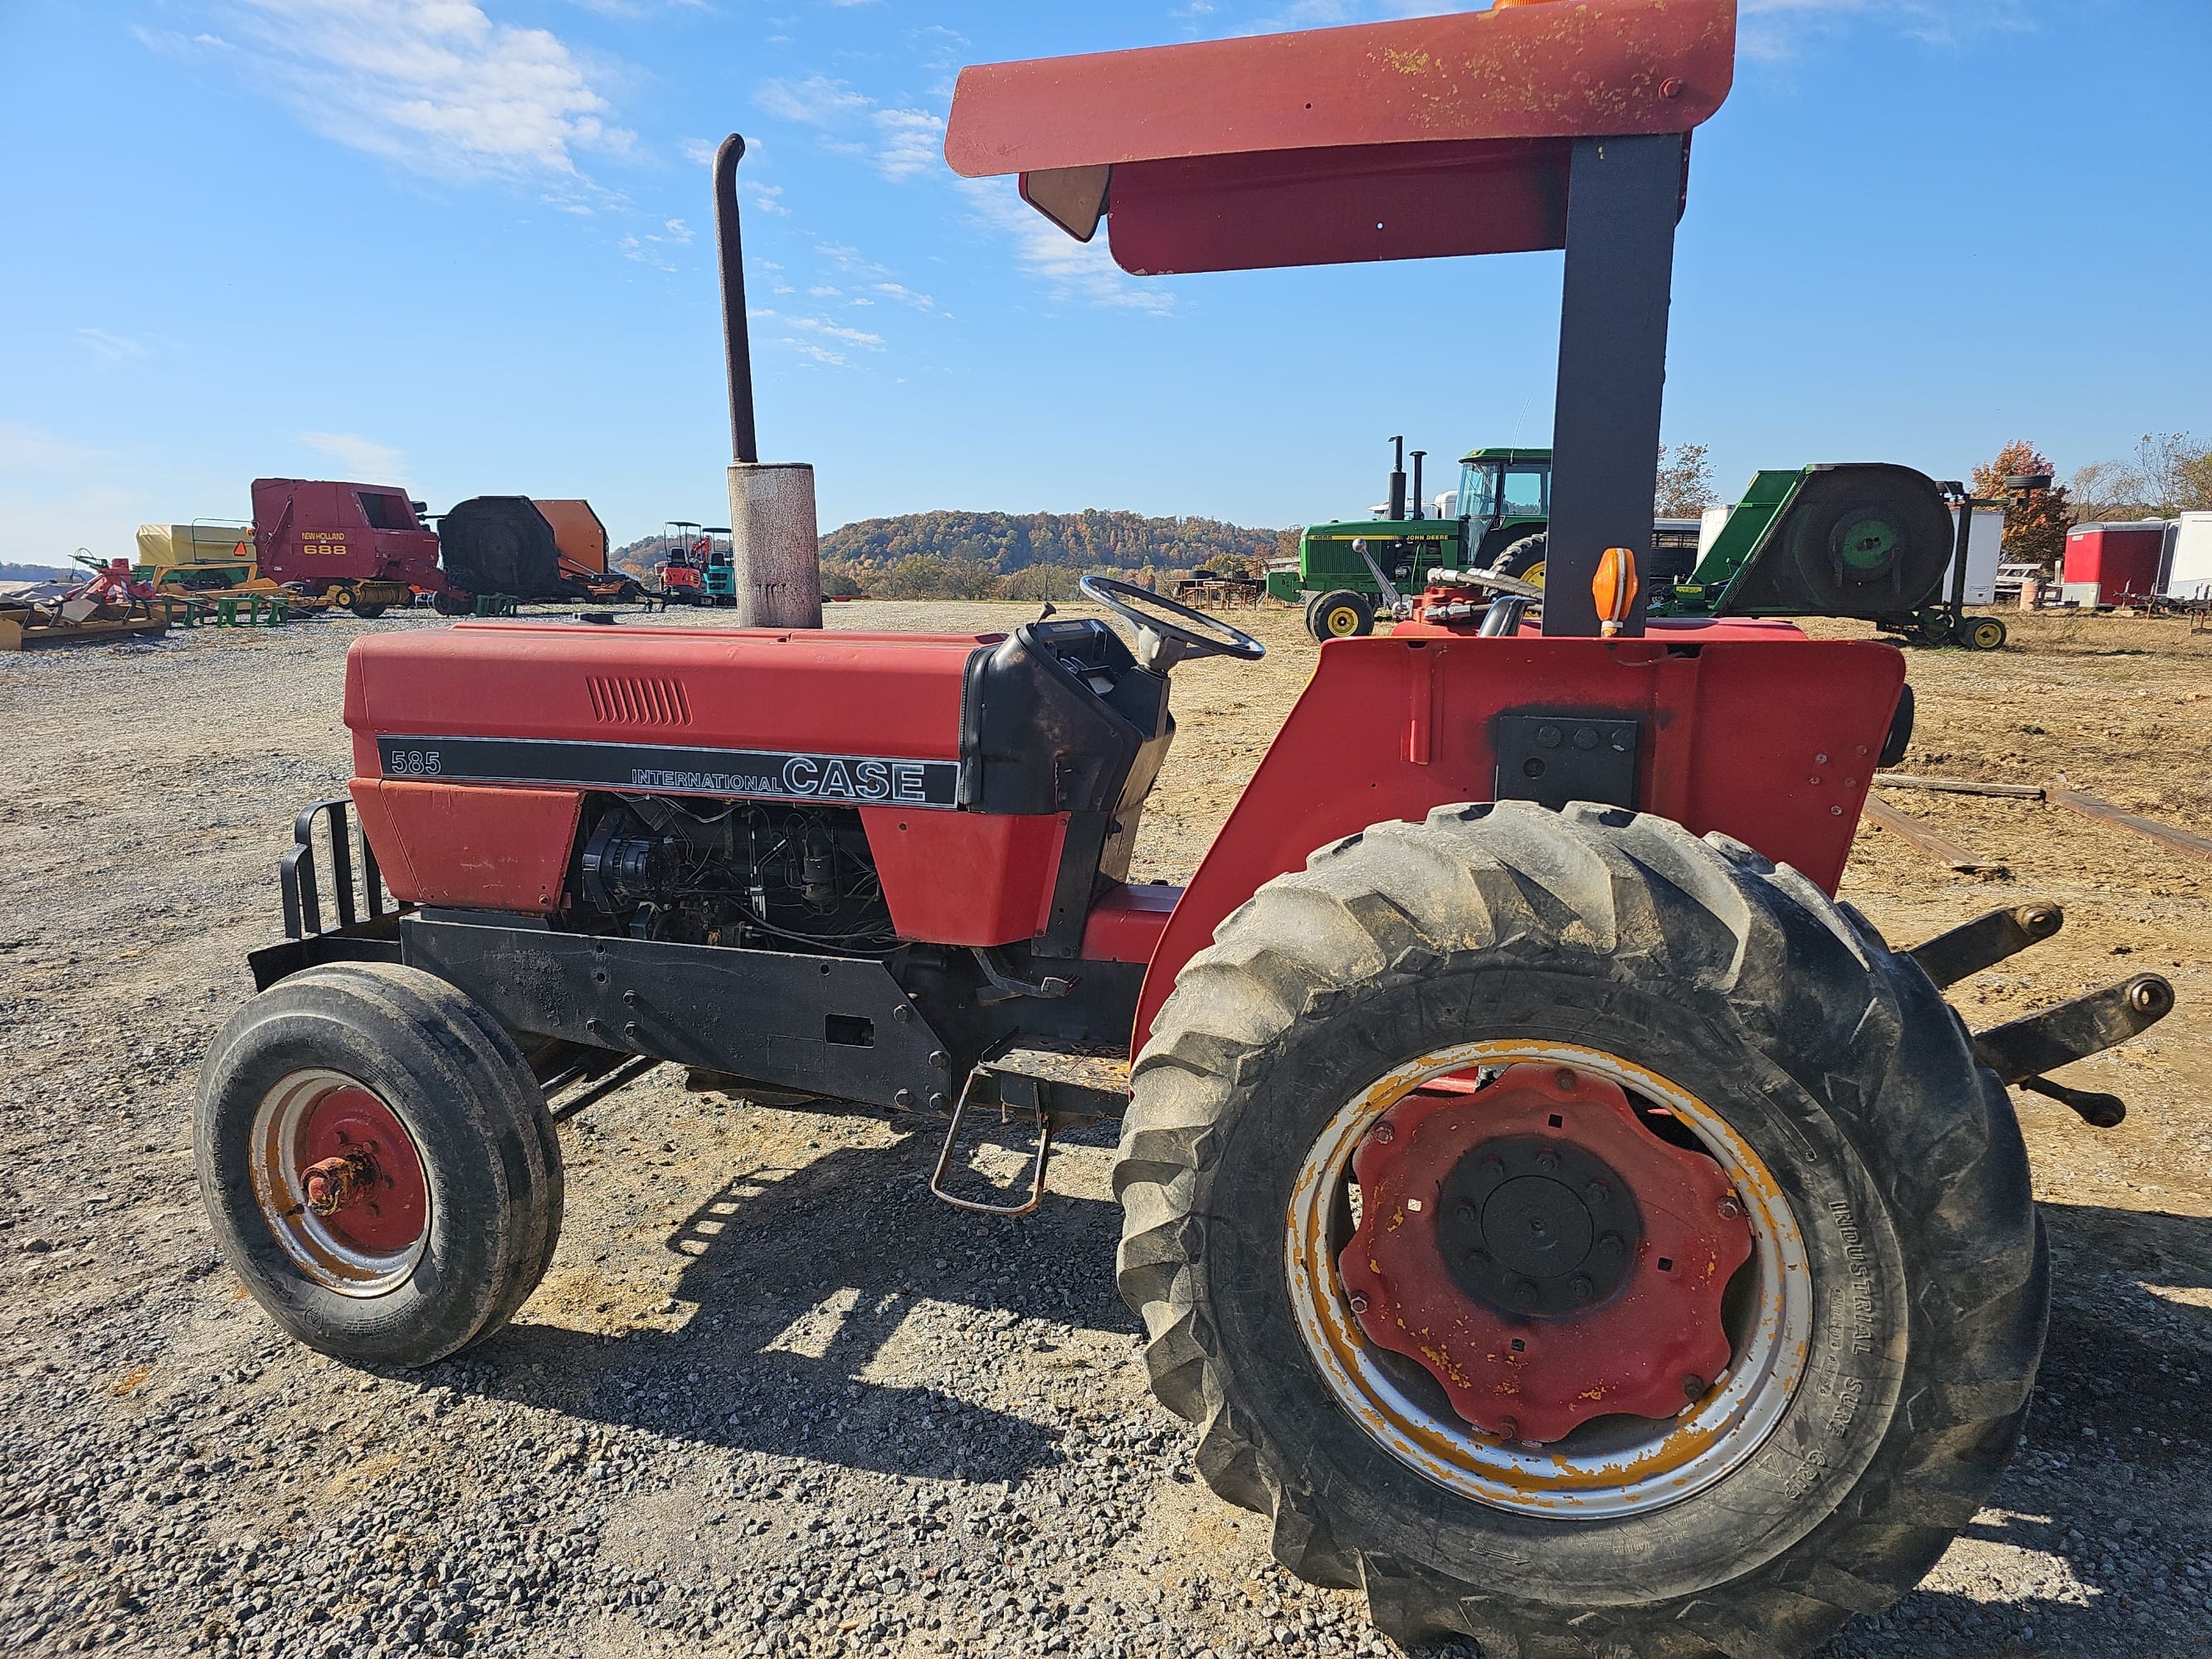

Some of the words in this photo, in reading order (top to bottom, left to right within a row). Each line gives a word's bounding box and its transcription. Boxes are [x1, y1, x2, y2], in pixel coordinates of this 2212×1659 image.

[301, 532, 316, 540] NEW
[316, 532, 345, 541] HOLLAND
[304, 545, 347, 555] 688
[391, 751, 441, 774] 585
[631, 768, 783, 793] INTERNATIONAL
[782, 757, 927, 801] CASE
[1828, 1200, 1873, 1356] INDUSTRIAL
[1825, 1377, 1864, 1438] SURE
[1784, 1452, 1827, 1500] GRIP
